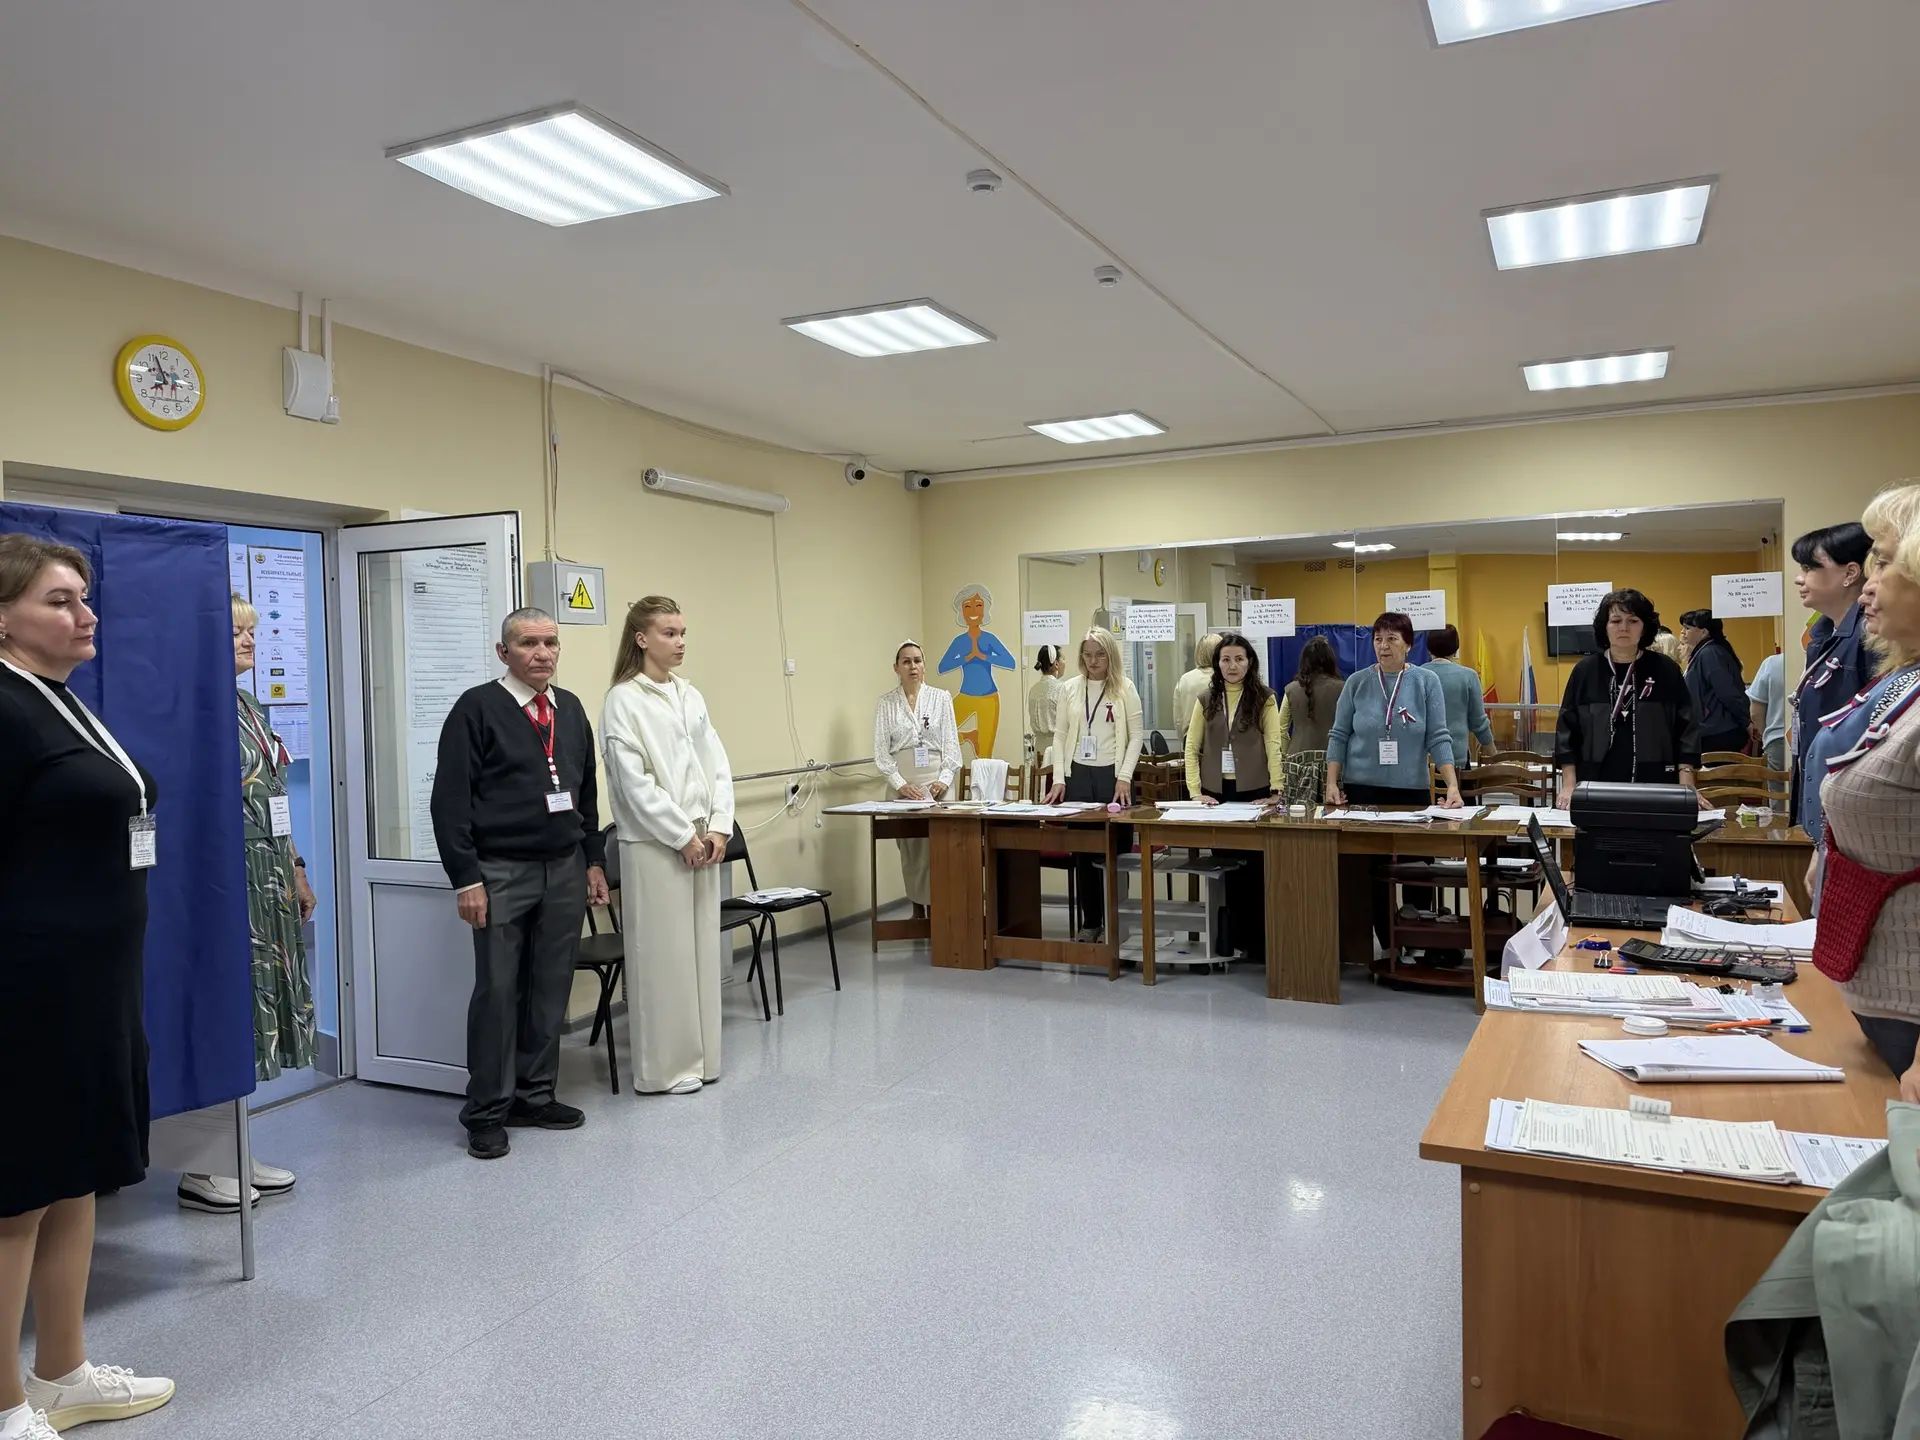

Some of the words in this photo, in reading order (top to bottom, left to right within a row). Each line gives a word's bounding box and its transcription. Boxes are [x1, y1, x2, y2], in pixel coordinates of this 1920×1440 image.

[148, 353, 155, 361] 11
[159, 351, 168, 360] 12
[175, 358, 179, 366] 1
[183, 368, 190, 378] 2
[187, 382, 194, 390] 3
[140, 388, 148, 398] 8
[149, 399, 156, 407] 7
[175, 402, 182, 411] 5
[162, 405, 170, 413] 6
